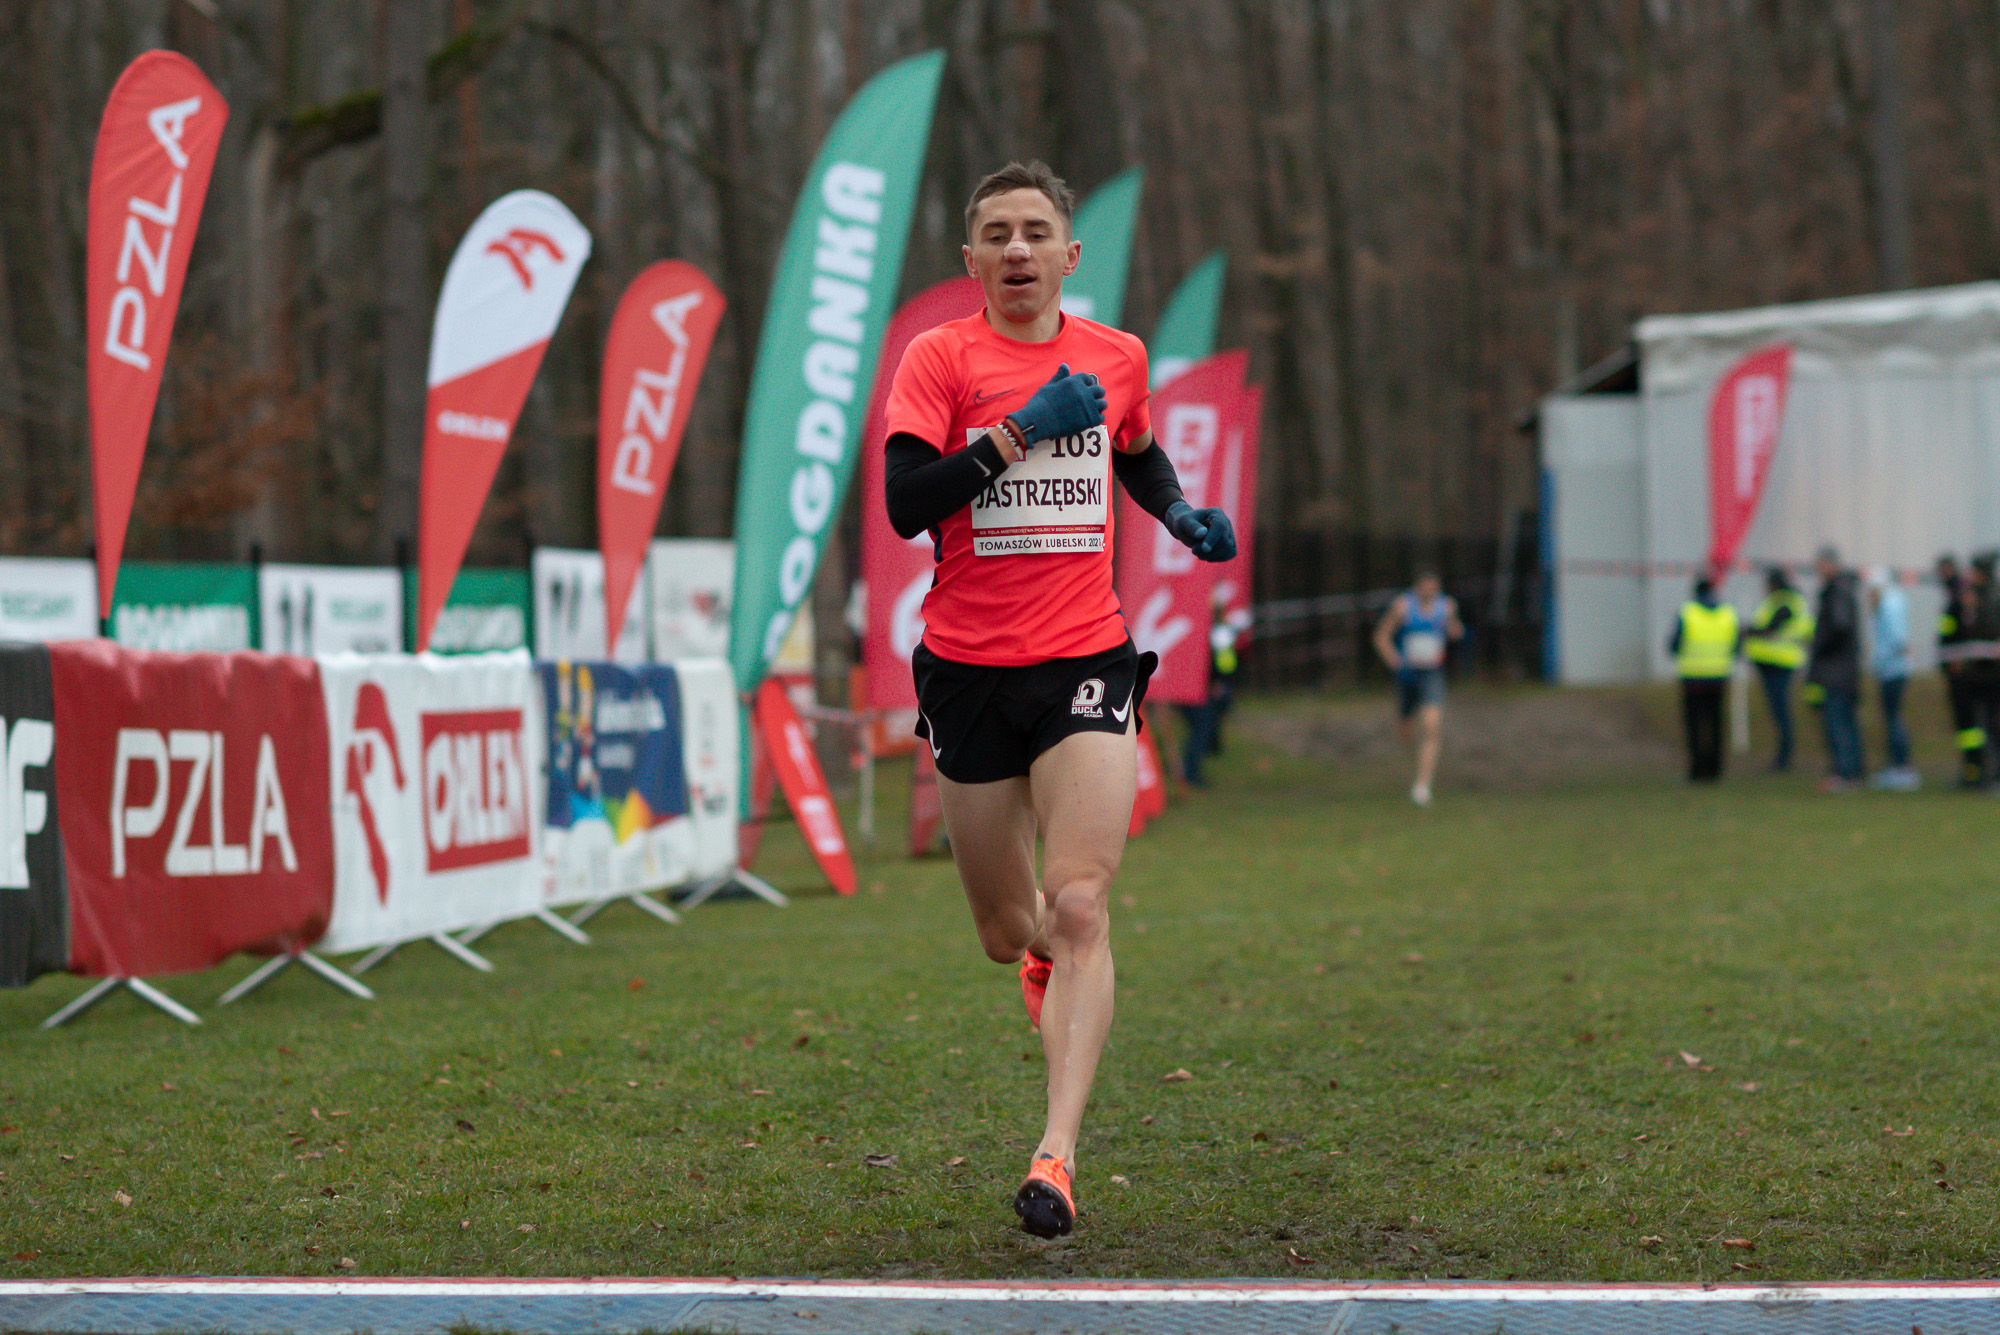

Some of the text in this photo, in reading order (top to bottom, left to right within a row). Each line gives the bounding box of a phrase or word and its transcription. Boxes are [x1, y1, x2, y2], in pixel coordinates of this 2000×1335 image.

[105, 96, 202, 371] PZLA
[611, 290, 703, 495] PZLA
[1050, 430, 1102, 458] 103
[976, 477, 1102, 512] JASTRZĘBSKI
[979, 537, 1043, 551] TOMASZÓW
[1045, 537, 1086, 548] LUBELSKI
[1071, 706, 1103, 714] DUCLA
[0, 714, 54, 889] F
[111, 728, 298, 879] PZLA
[425, 729, 523, 853] ORLEN
